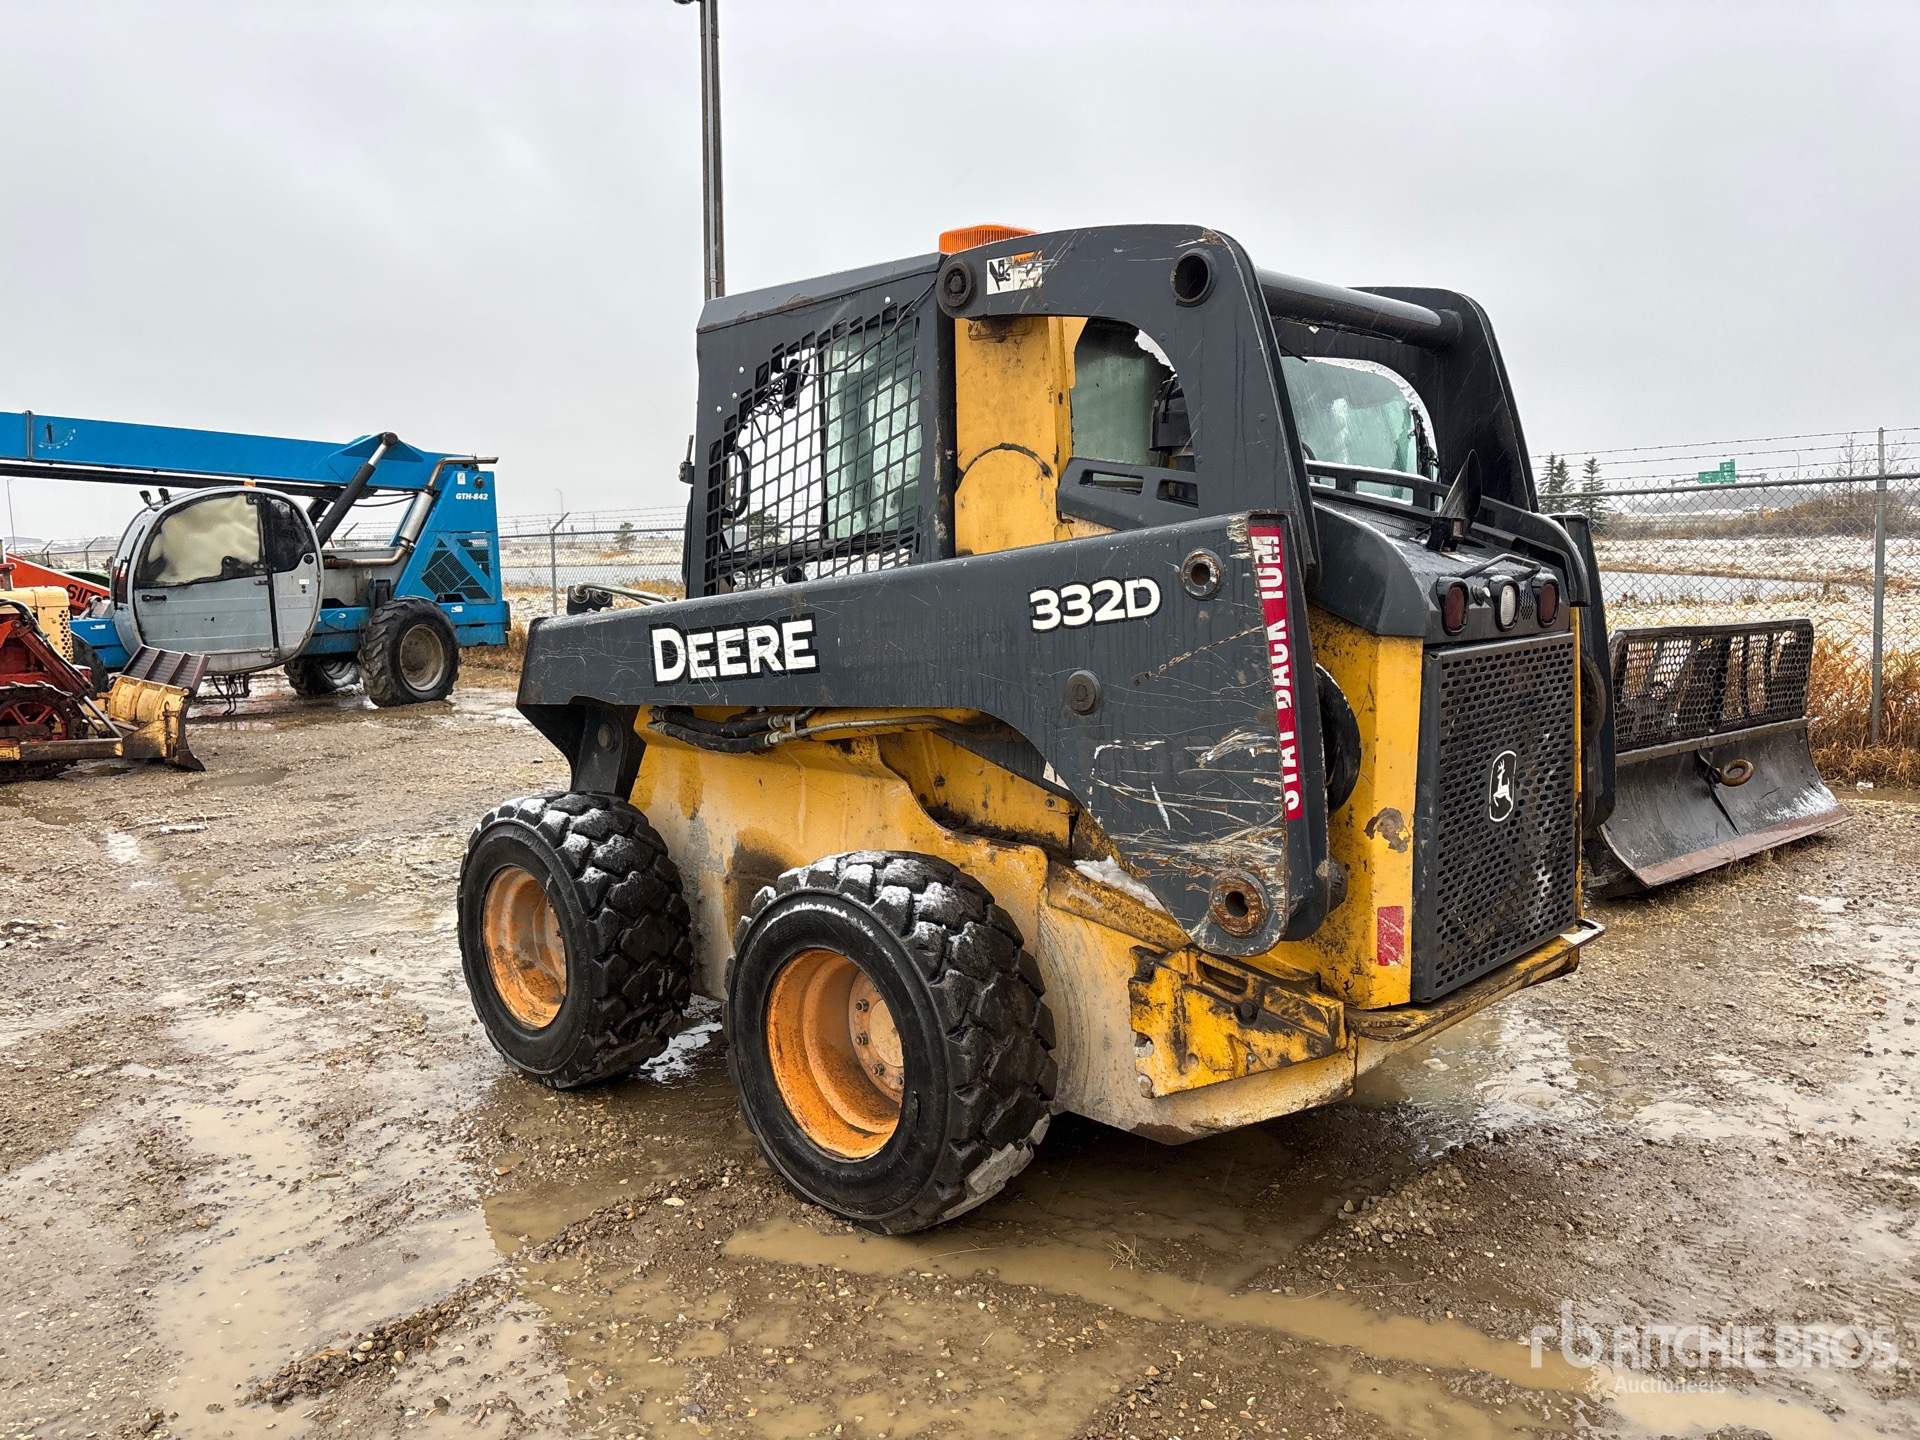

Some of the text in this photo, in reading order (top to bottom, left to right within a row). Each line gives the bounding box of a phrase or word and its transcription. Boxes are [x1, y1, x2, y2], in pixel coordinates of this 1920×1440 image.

[455, 492, 489, 501] GTH-842
[1030, 578, 1161, 630] 332D
[651, 619, 817, 682] DEERE
